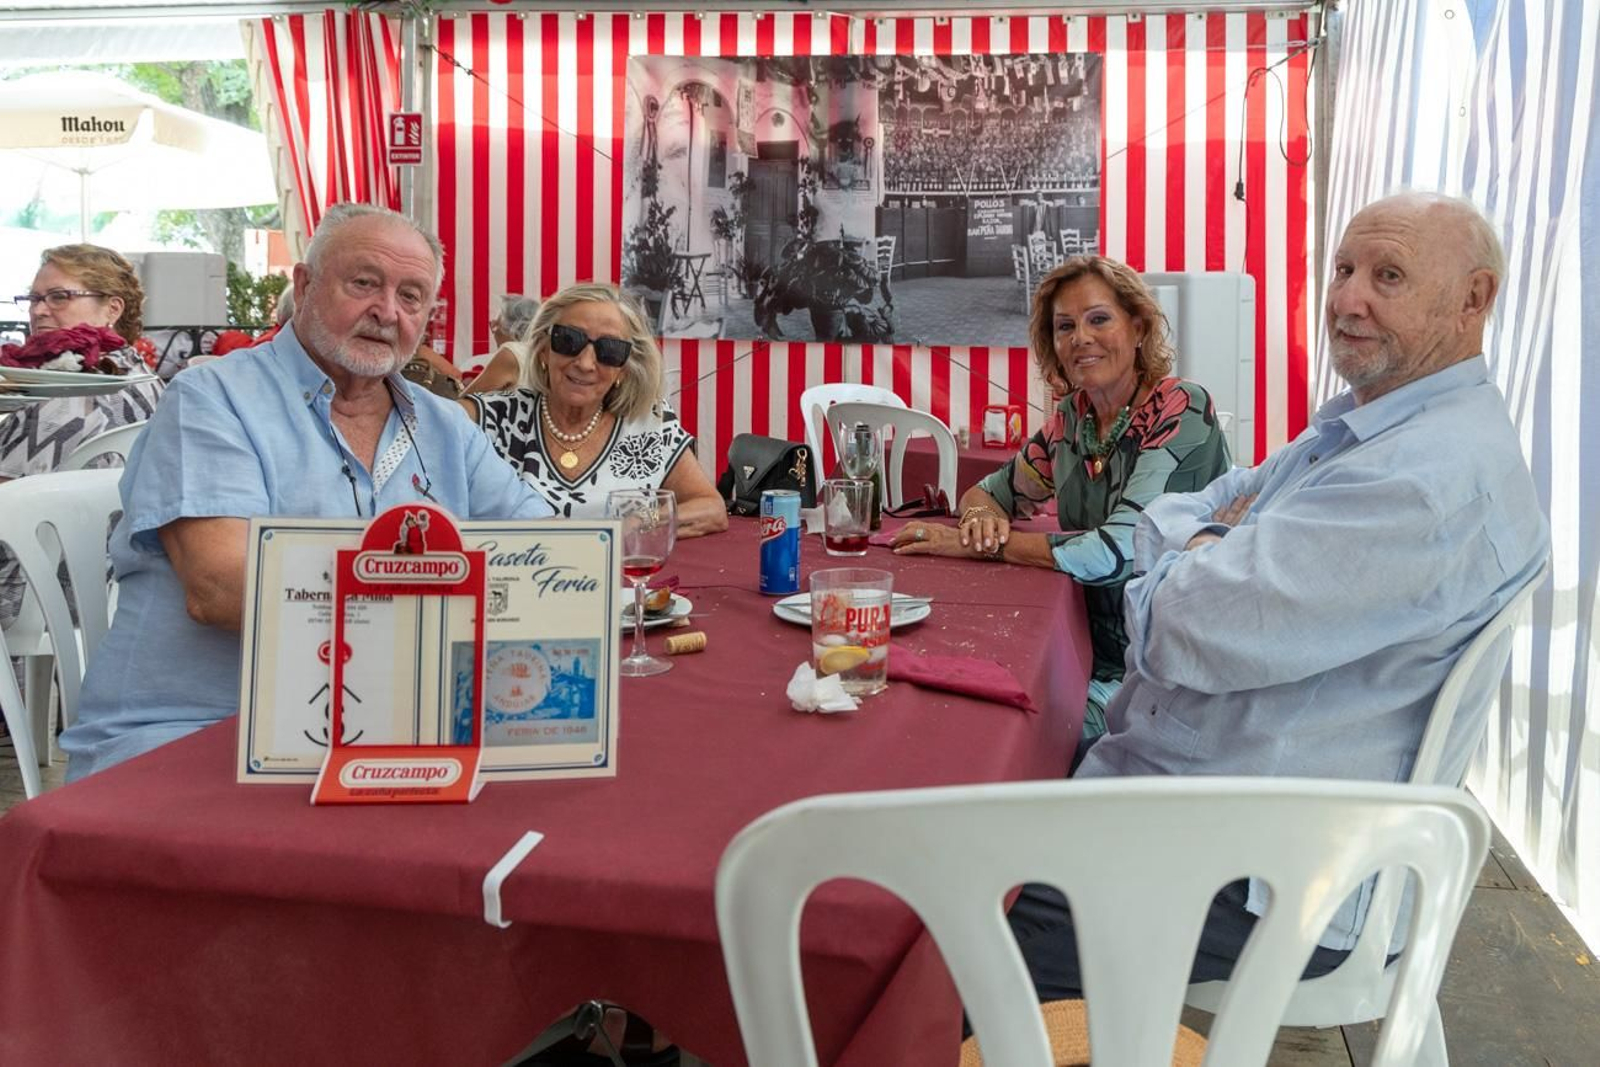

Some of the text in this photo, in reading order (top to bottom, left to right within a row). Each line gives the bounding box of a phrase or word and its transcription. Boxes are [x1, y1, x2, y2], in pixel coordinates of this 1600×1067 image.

[61, 116, 125, 132] Mahou
[974, 200, 1005, 209] POLLOS
[364, 558, 460, 577] Cruzcampo
[532, 566, 600, 598] Feria
[507, 727, 539, 738] FERIA
[352, 765, 449, 781] Cruzcampo
